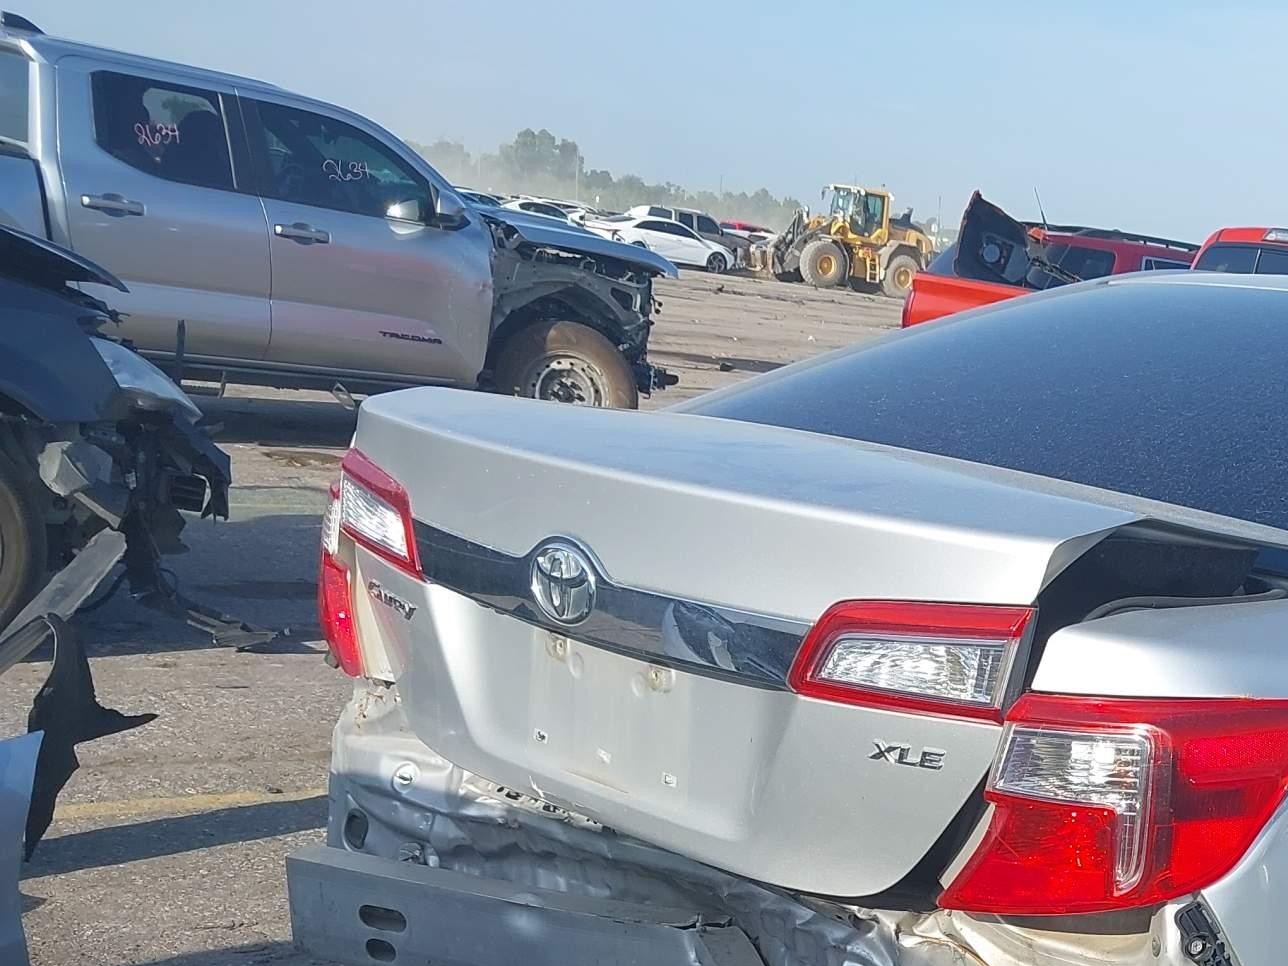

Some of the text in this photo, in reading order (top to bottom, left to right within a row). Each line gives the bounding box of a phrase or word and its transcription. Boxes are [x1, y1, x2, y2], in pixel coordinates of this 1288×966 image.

[134, 122, 180, 146] 2634
[322, 159, 370, 182] 2634
[378, 328, 443, 345] TACOMA
[867, 739, 946, 771] XLE
